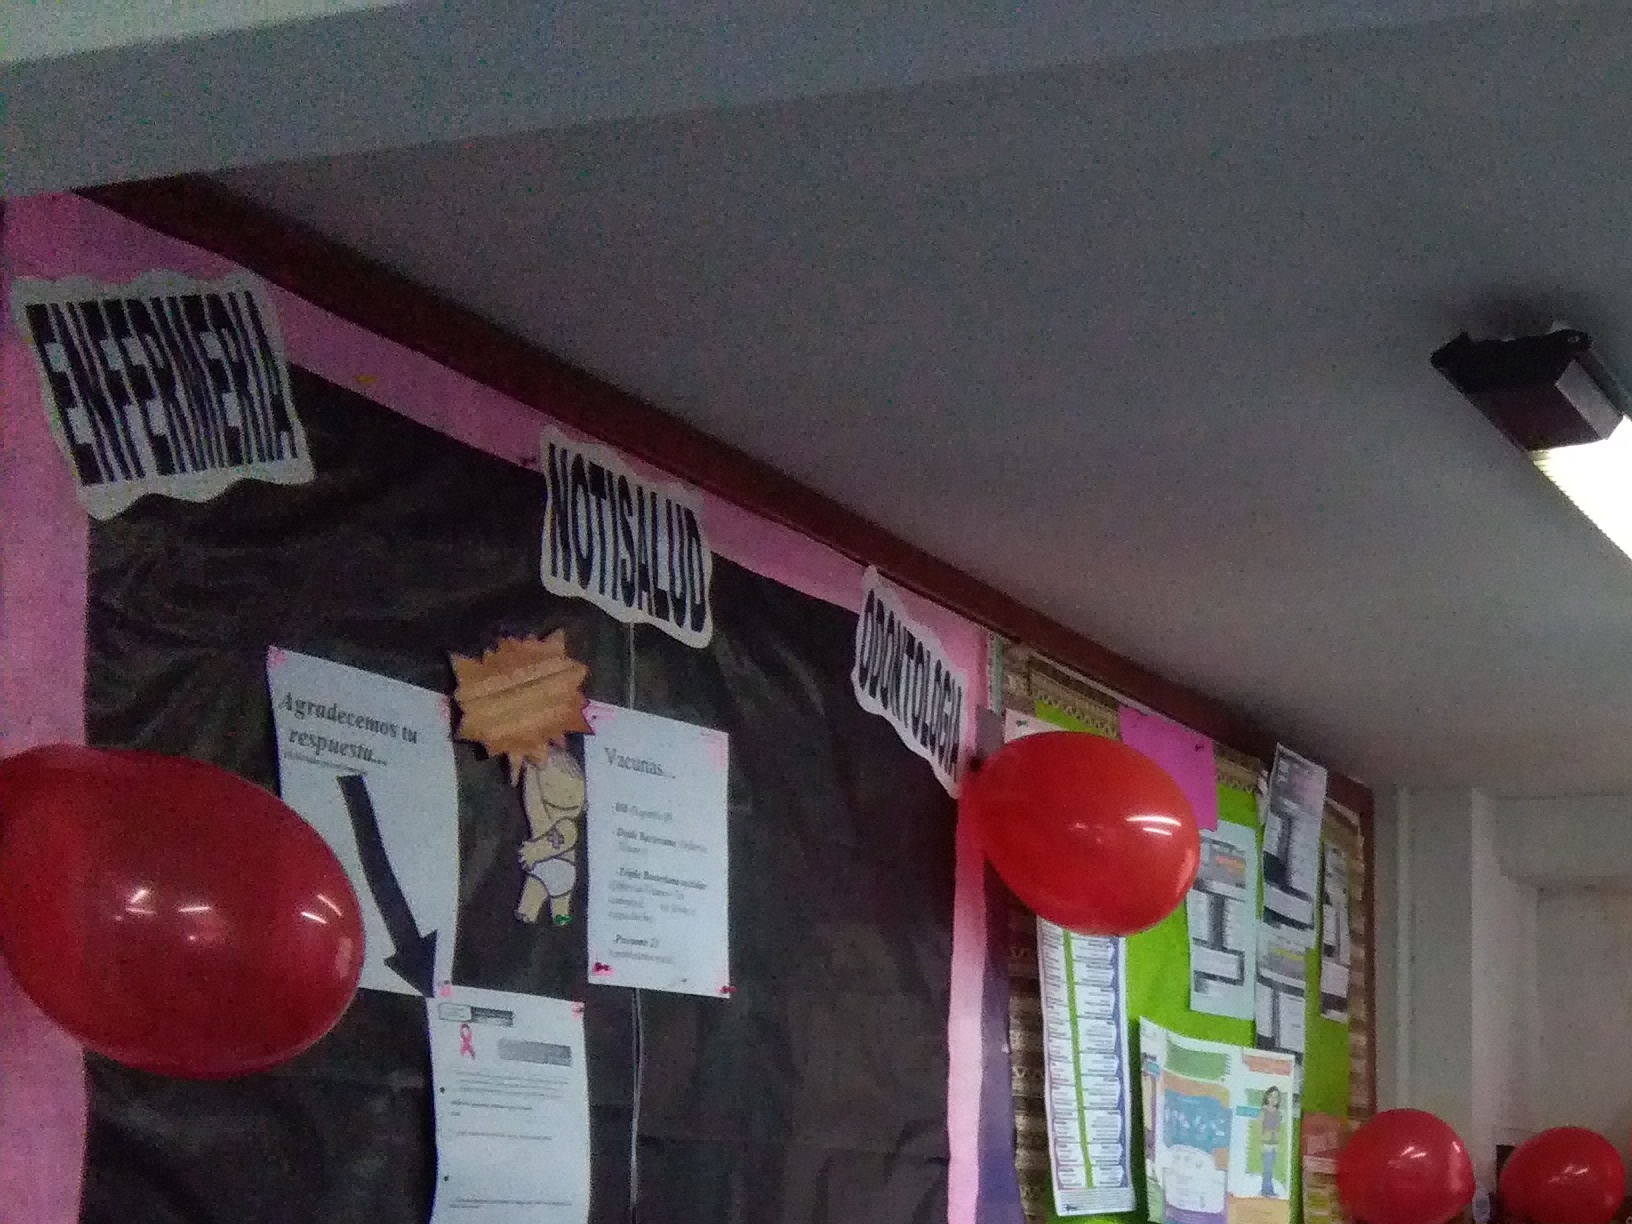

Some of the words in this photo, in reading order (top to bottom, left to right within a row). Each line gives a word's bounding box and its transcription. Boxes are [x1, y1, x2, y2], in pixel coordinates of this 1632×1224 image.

[25, 290, 299, 486] ENFERMERIA
[548, 442, 706, 634] NOTISALUD
[278, 691, 398, 738] Agradecemos
[402, 725, 418, 744] tu
